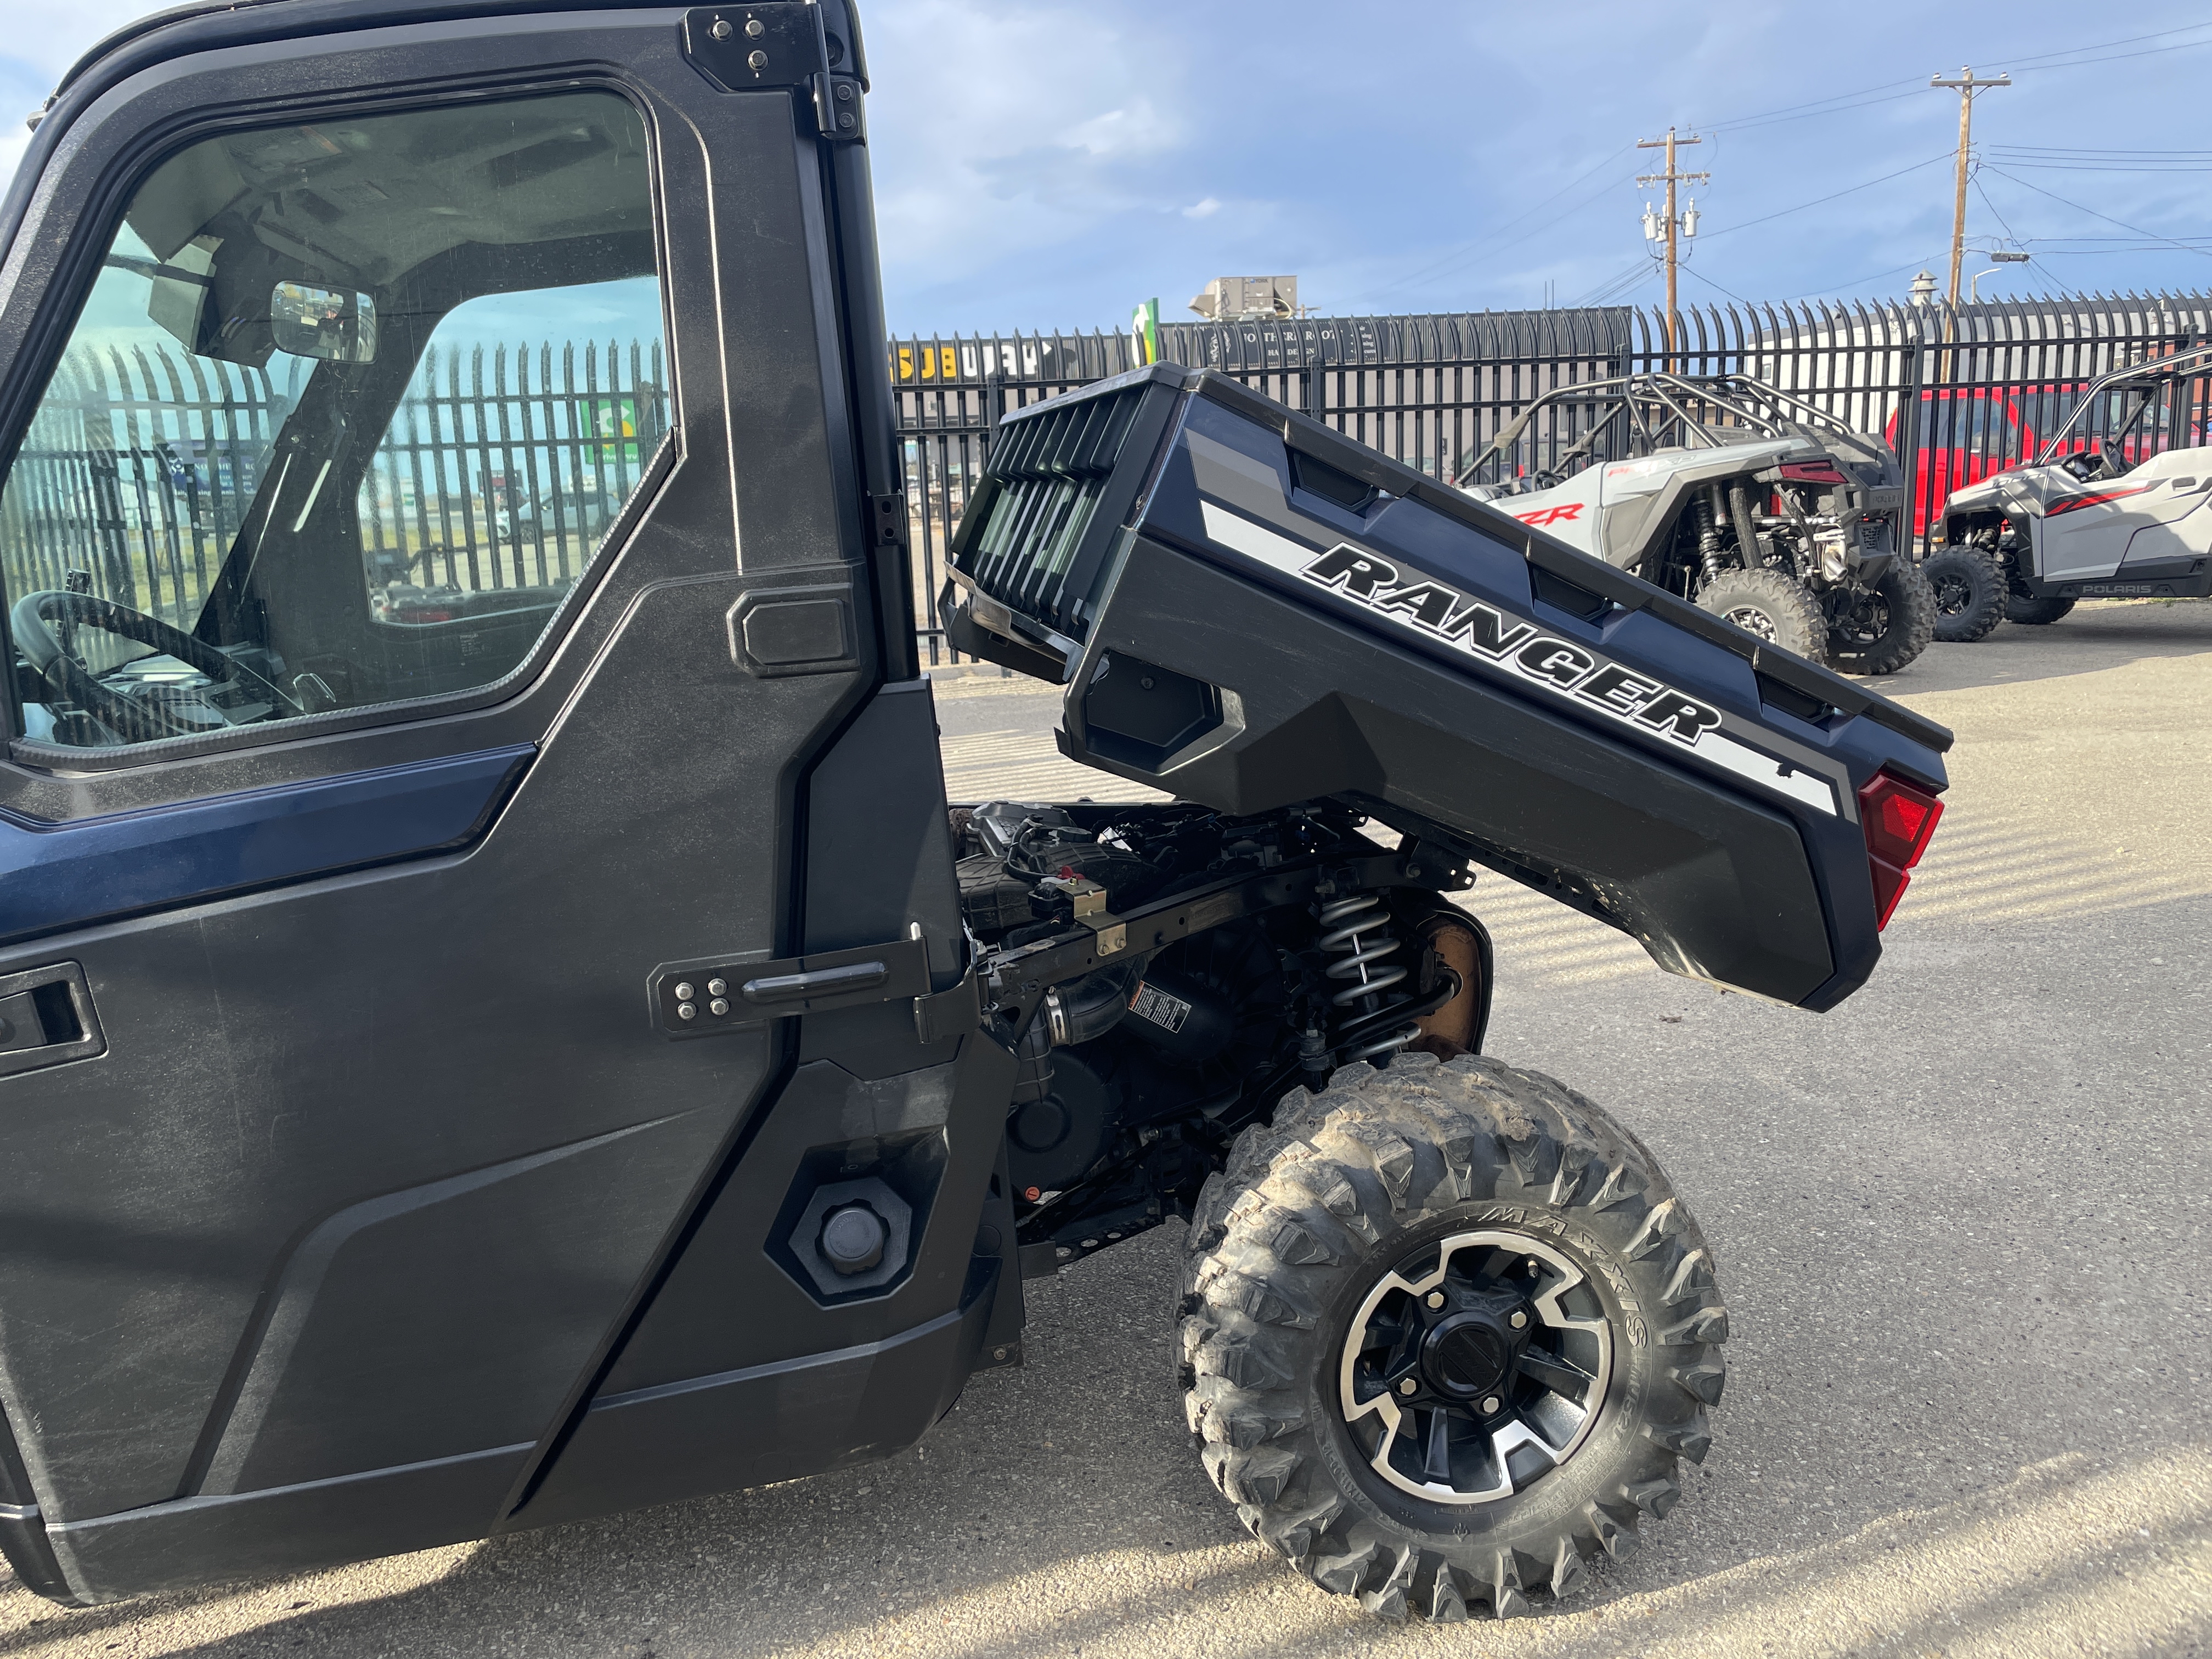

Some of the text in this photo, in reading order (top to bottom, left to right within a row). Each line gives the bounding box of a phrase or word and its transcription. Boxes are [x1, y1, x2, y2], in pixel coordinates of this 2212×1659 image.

[1513, 503, 1585, 527] ZR
[1300, 542, 1722, 751] RANGER
[2083, 585, 2152, 594] POLARIS
[1477, 1207, 1648, 1441] MAXXIS MU521
